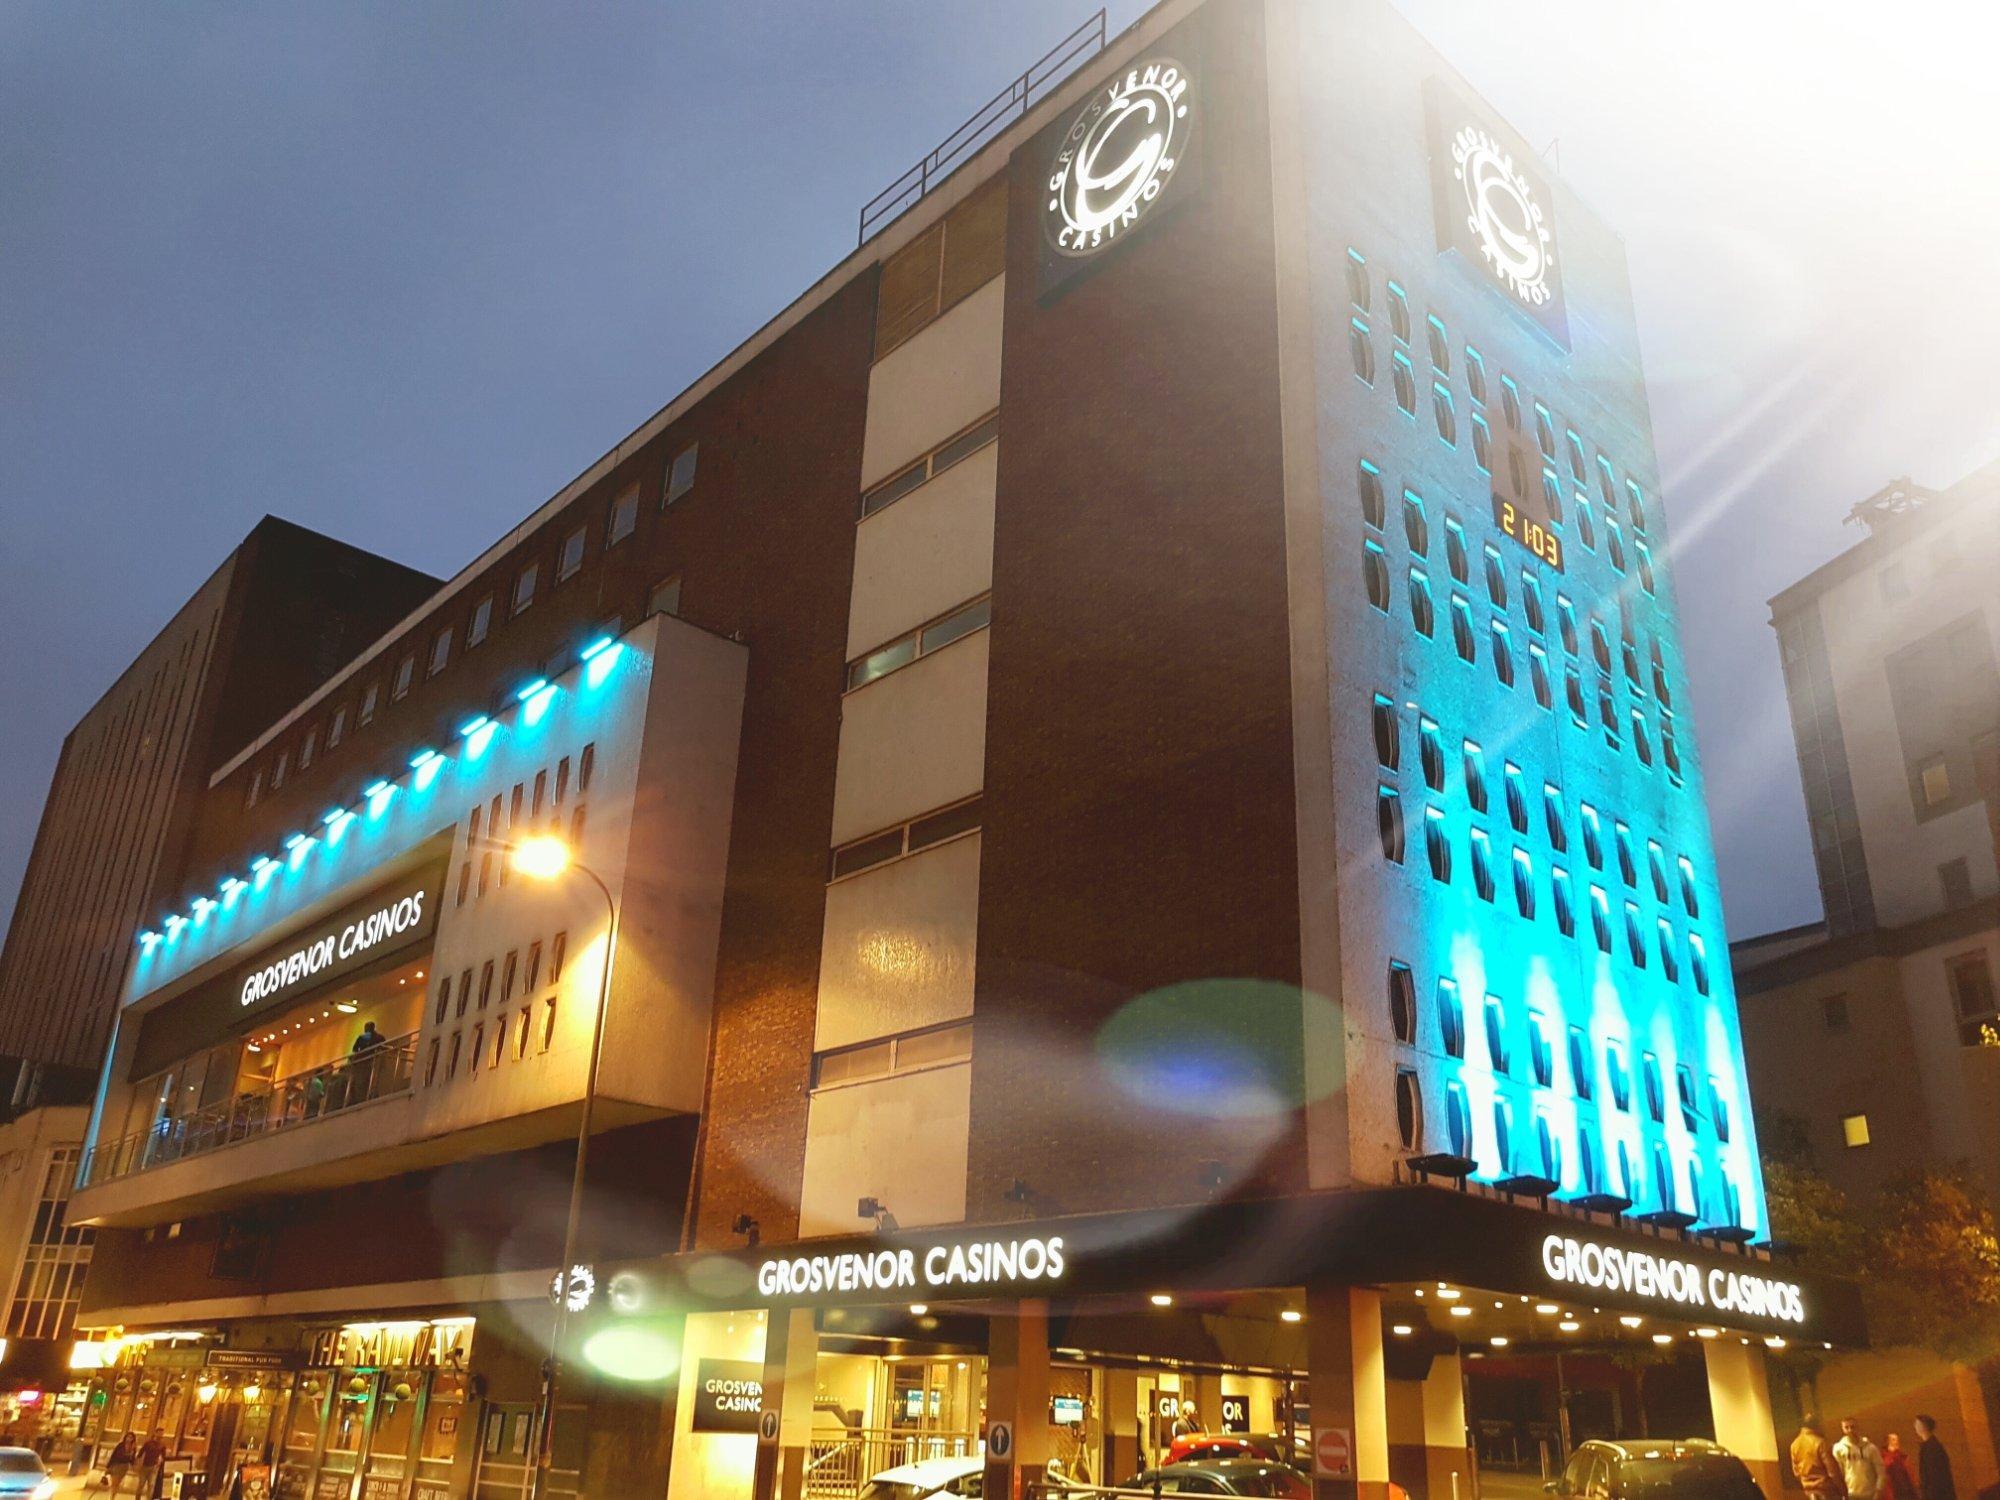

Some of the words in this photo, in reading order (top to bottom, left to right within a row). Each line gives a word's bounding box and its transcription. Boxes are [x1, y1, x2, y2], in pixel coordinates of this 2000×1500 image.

[1049, 64, 1188, 192] GROSVENOR
[1058, 156, 1175, 250] CASINOS
[1451, 126, 1550, 243] GROSVENOR
[1467, 213, 1551, 305] CASINOS
[241, 935, 336, 1006] GROSVENOR
[338, 890, 425, 960] CASINOS
[758, 1250, 915, 1296] GROSVENOR
[924, 1236, 1065, 1286] CASINOS
[1542, 1234, 1705, 1306] GROSVENOR
[1708, 1269, 1806, 1323] CASINOS
[219, 1355, 254, 1363] TRADITIONAL
[308, 1329, 347, 1366] THE
[352, 1325, 465, 1366] RAILWAY
